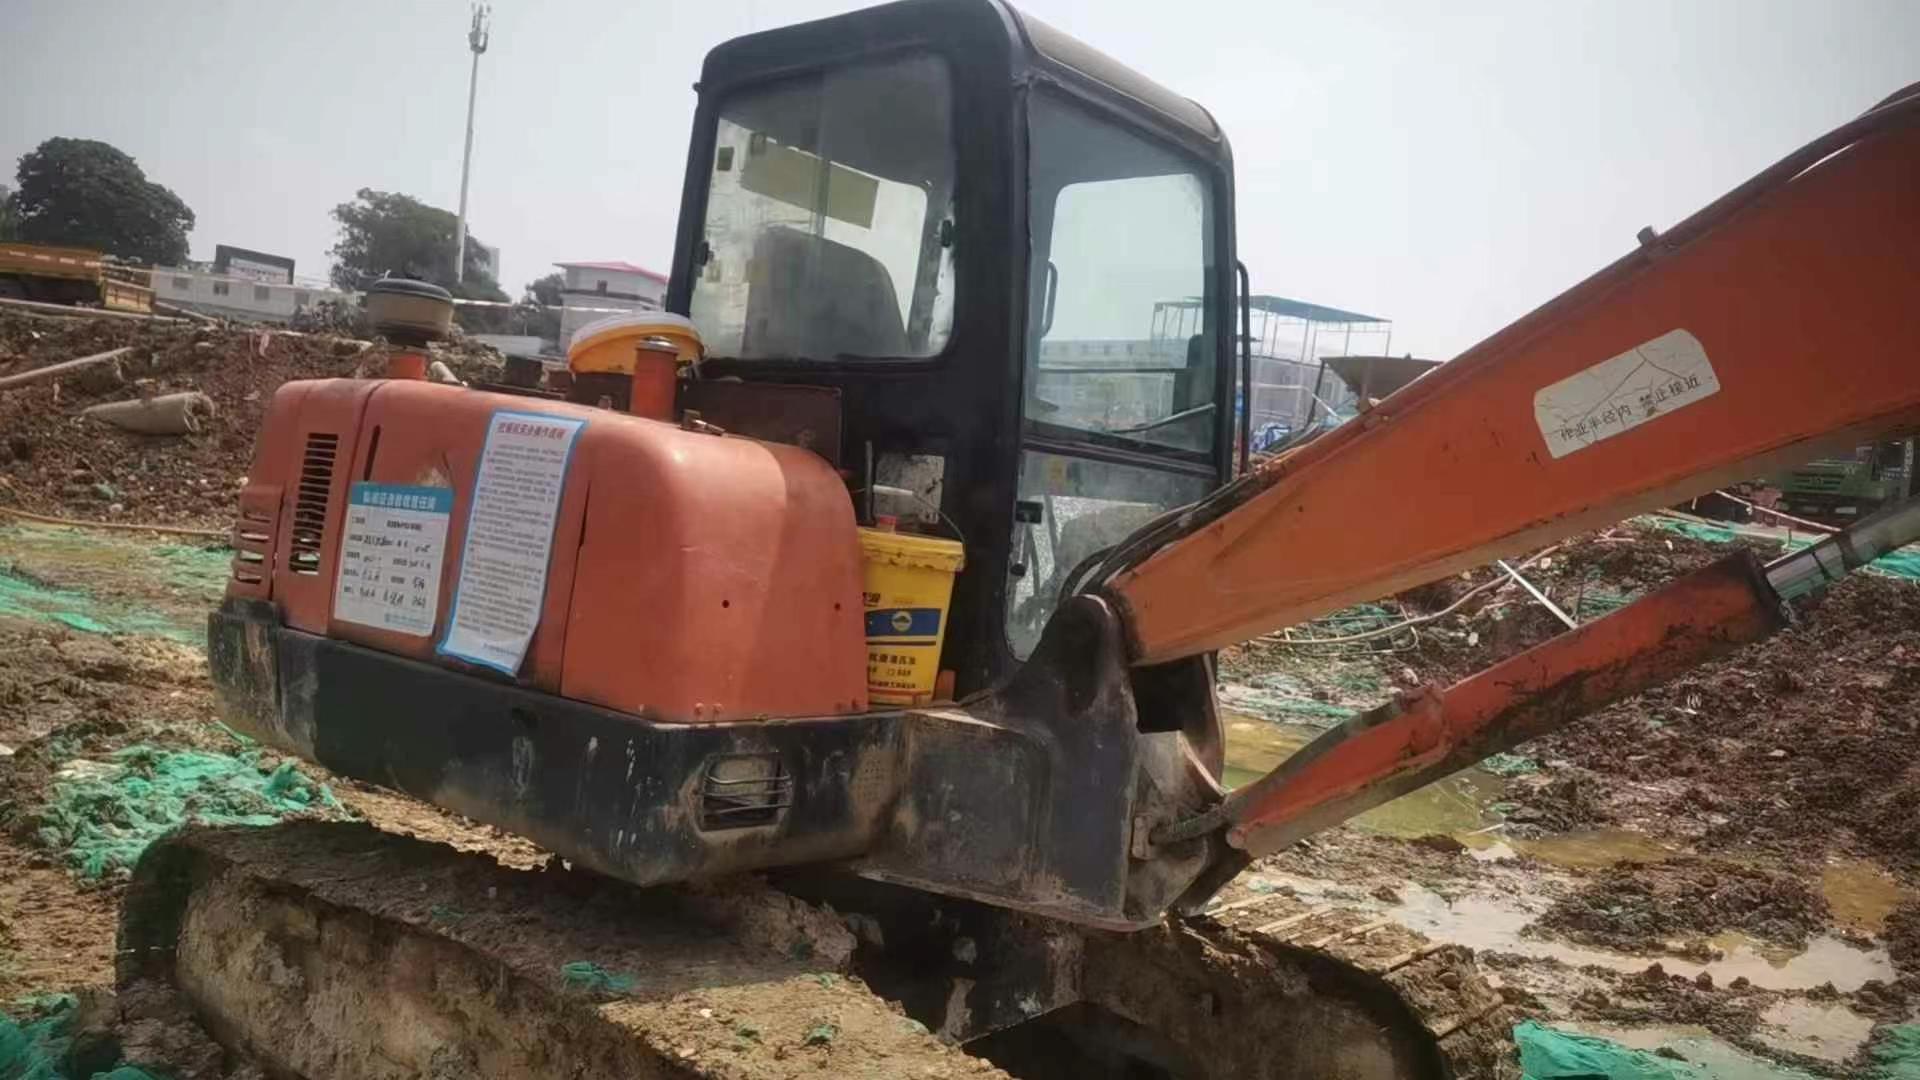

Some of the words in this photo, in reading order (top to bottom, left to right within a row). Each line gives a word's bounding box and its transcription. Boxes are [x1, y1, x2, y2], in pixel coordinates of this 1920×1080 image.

[1560, 405, 1633, 441] 作业半径内
[1638, 374, 1700, 411] 禁止接近
